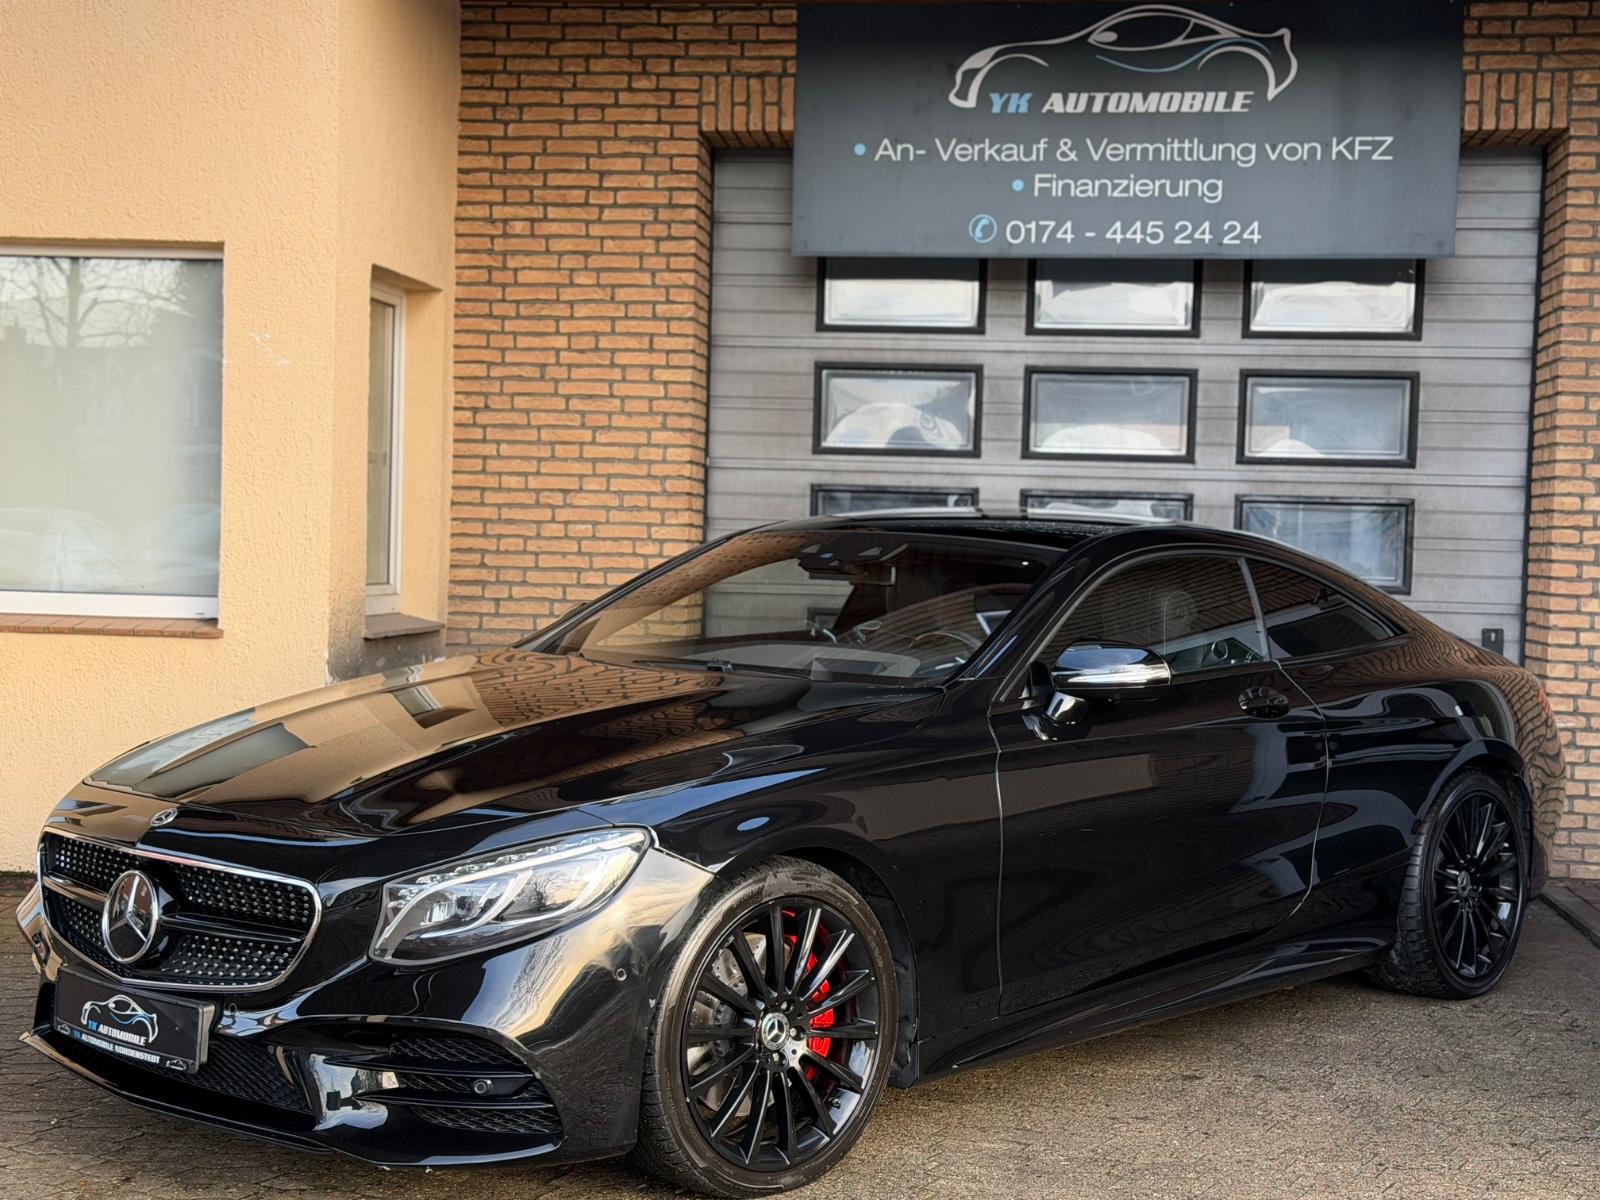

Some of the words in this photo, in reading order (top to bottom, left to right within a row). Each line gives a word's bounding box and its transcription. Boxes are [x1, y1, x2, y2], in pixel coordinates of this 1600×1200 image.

[989, 92, 1034, 113] YK
[1041, 90, 1255, 113] AUTOMOBILE
[874, 138, 927, 161] An-
[934, 137, 1049, 162] Verkauf
[1056, 138, 1078, 162] &
[1086, 137, 1257, 168] Vermittlung
[1265, 142, 1322, 161] von
[1332, 136, 1395, 161] KFZ
[1034, 173, 1224, 204] Finanzierung
[1005, 220, 1076, 244] 0174
[1105, 220, 1165, 244] 445
[1174, 220, 1213, 244] 24
[1222, 220, 1262, 244] 24
[98, 1023, 147, 1046] AUTOMOBILE
[81, 1033, 115, 1051] AUTOMOBILE
[114, 1044, 160, 1064] NORDERSTEDT
